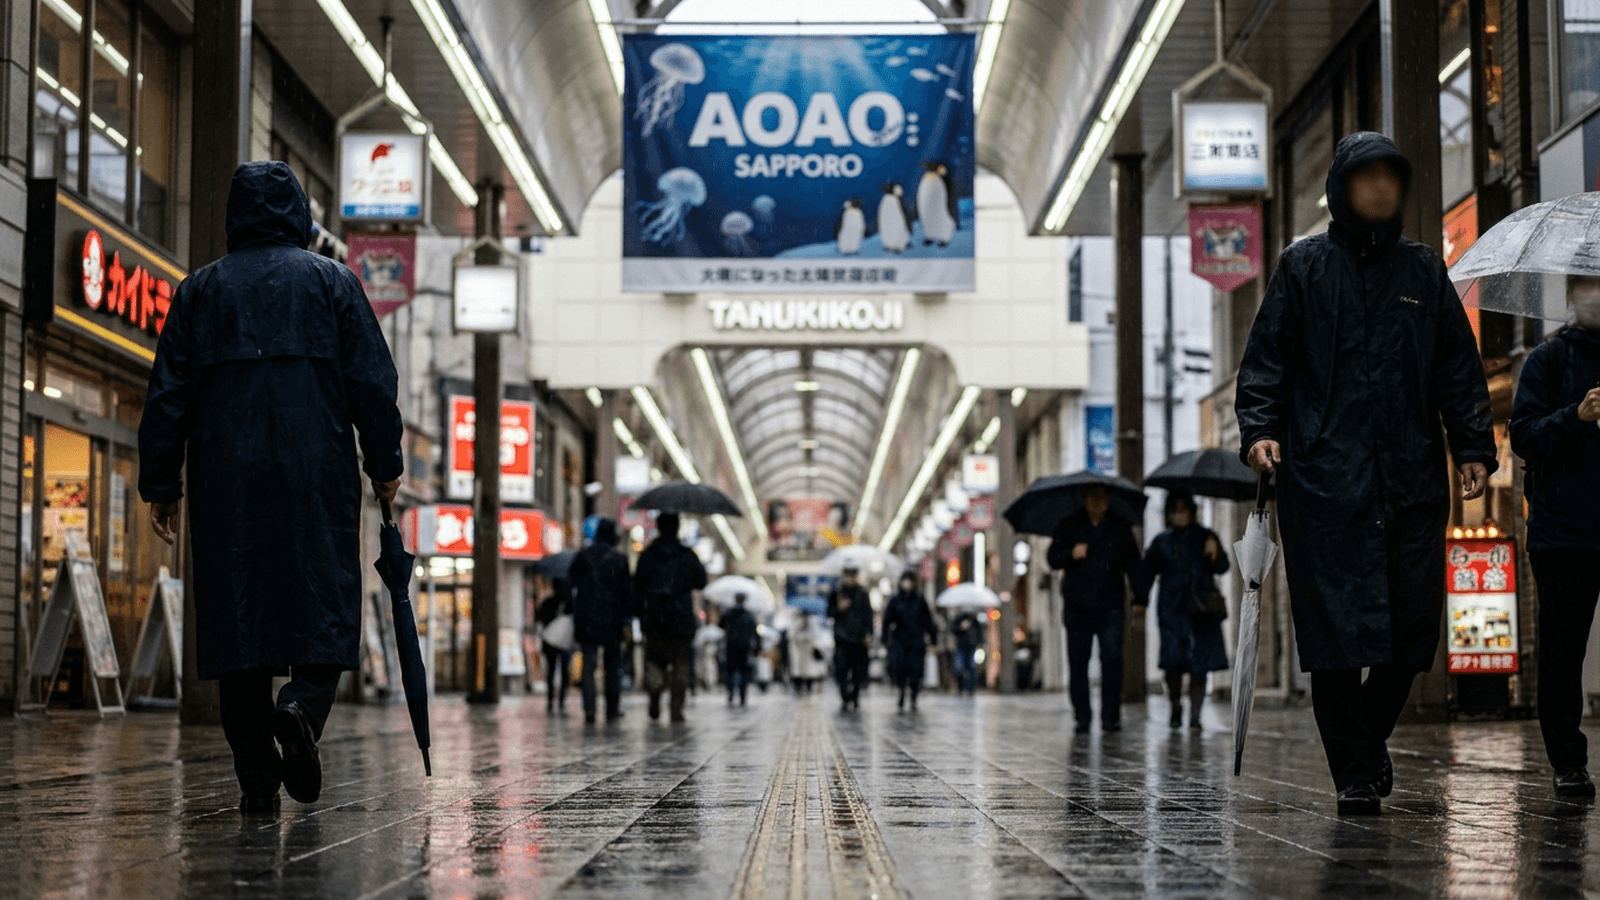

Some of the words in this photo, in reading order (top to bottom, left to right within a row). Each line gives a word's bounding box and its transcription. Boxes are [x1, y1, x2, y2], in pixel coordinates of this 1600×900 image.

[688, 91, 905, 147] AOAO
[734, 153, 863, 178] SAPPORO
[707, 299, 904, 331] TANUKIKOJI
